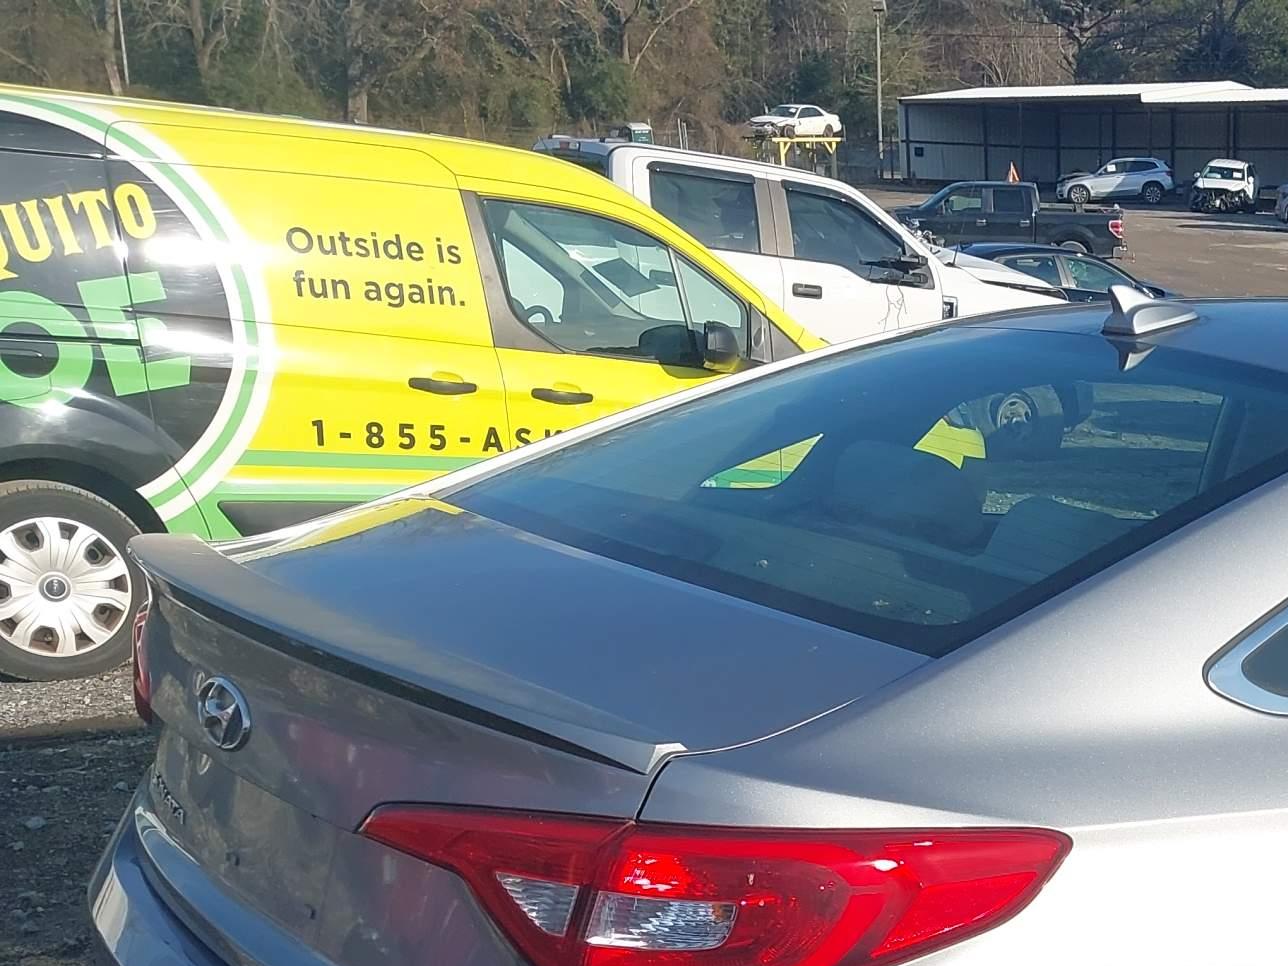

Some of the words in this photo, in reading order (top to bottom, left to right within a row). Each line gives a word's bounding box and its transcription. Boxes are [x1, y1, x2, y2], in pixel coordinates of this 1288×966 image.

[286, 226, 424, 262] Outside
[435, 237, 462, 265] is
[293, 270, 351, 300] fun
[364, 278, 466, 308] again.
